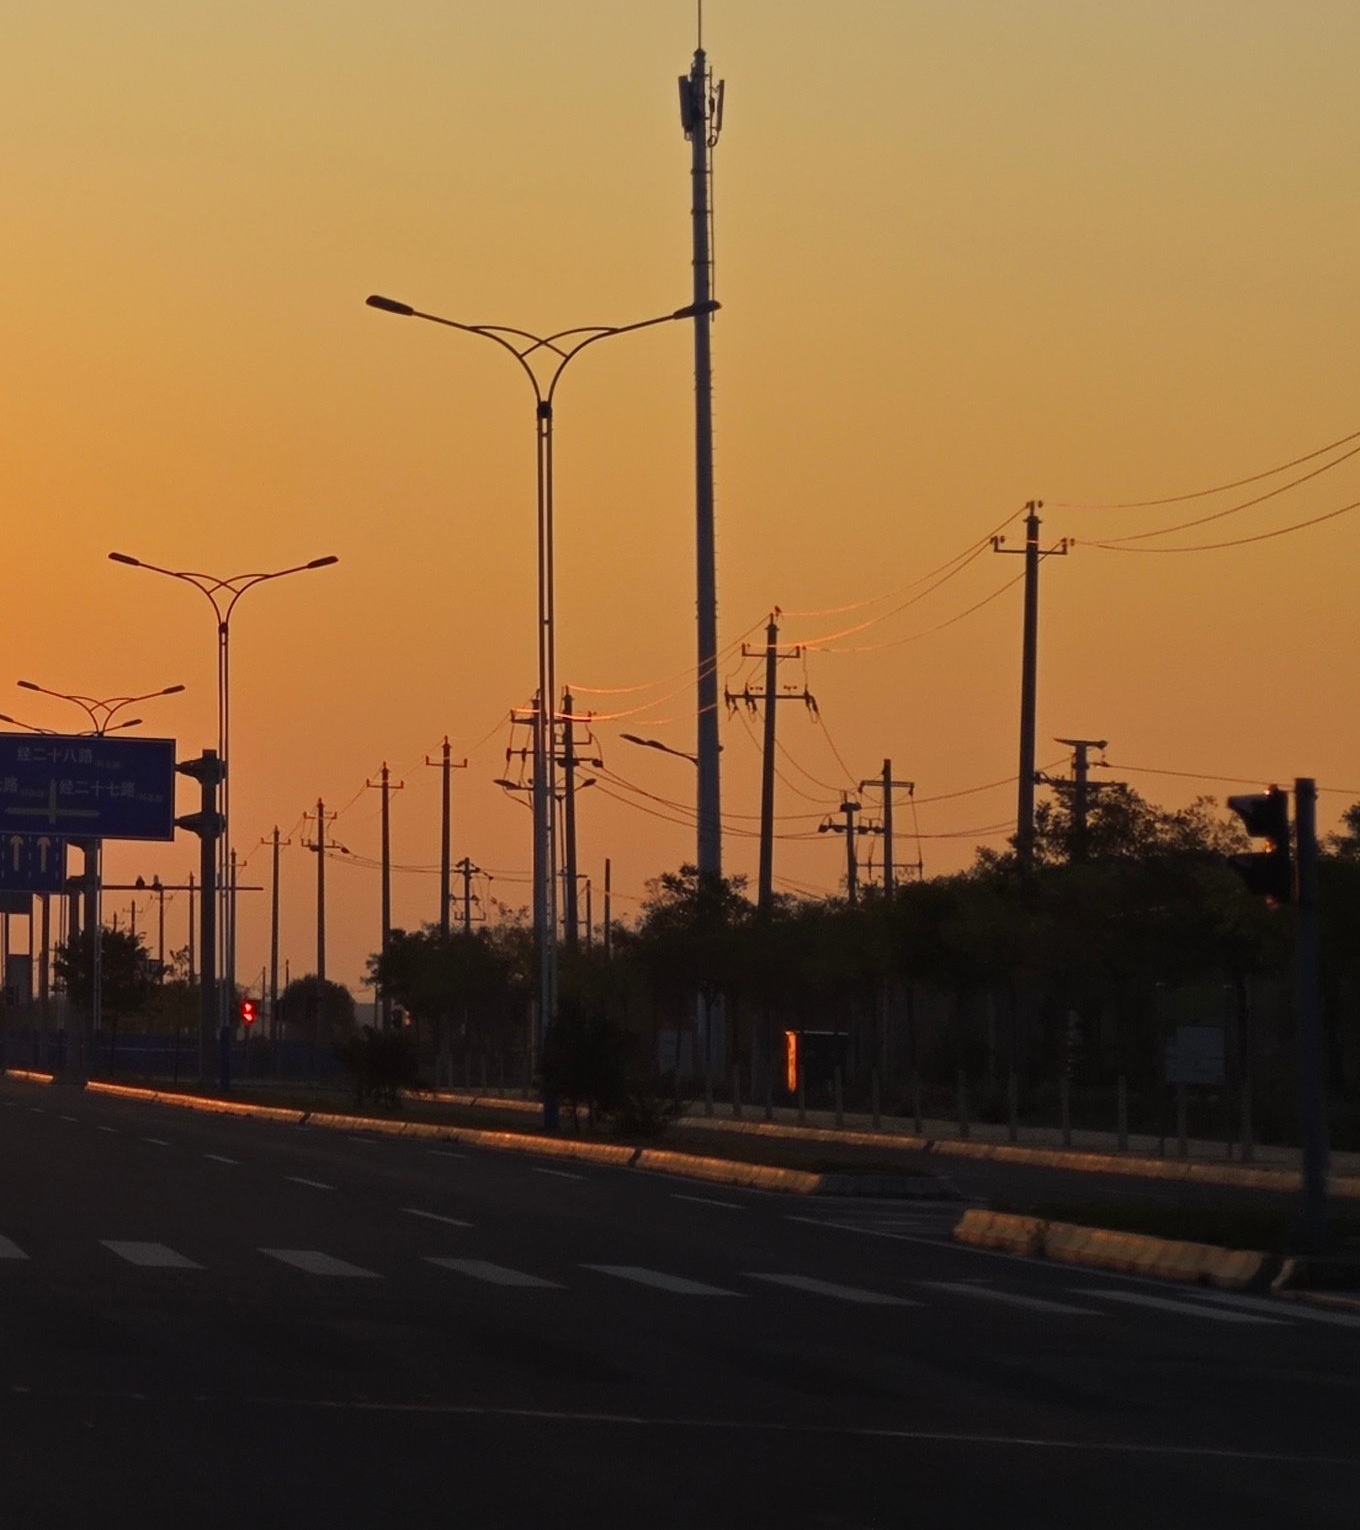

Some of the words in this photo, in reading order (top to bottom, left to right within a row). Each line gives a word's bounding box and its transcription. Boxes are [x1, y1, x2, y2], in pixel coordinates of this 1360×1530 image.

[17, 746, 92, 763] 经二十八路
[59, 779, 135, 798] 经二十七路
